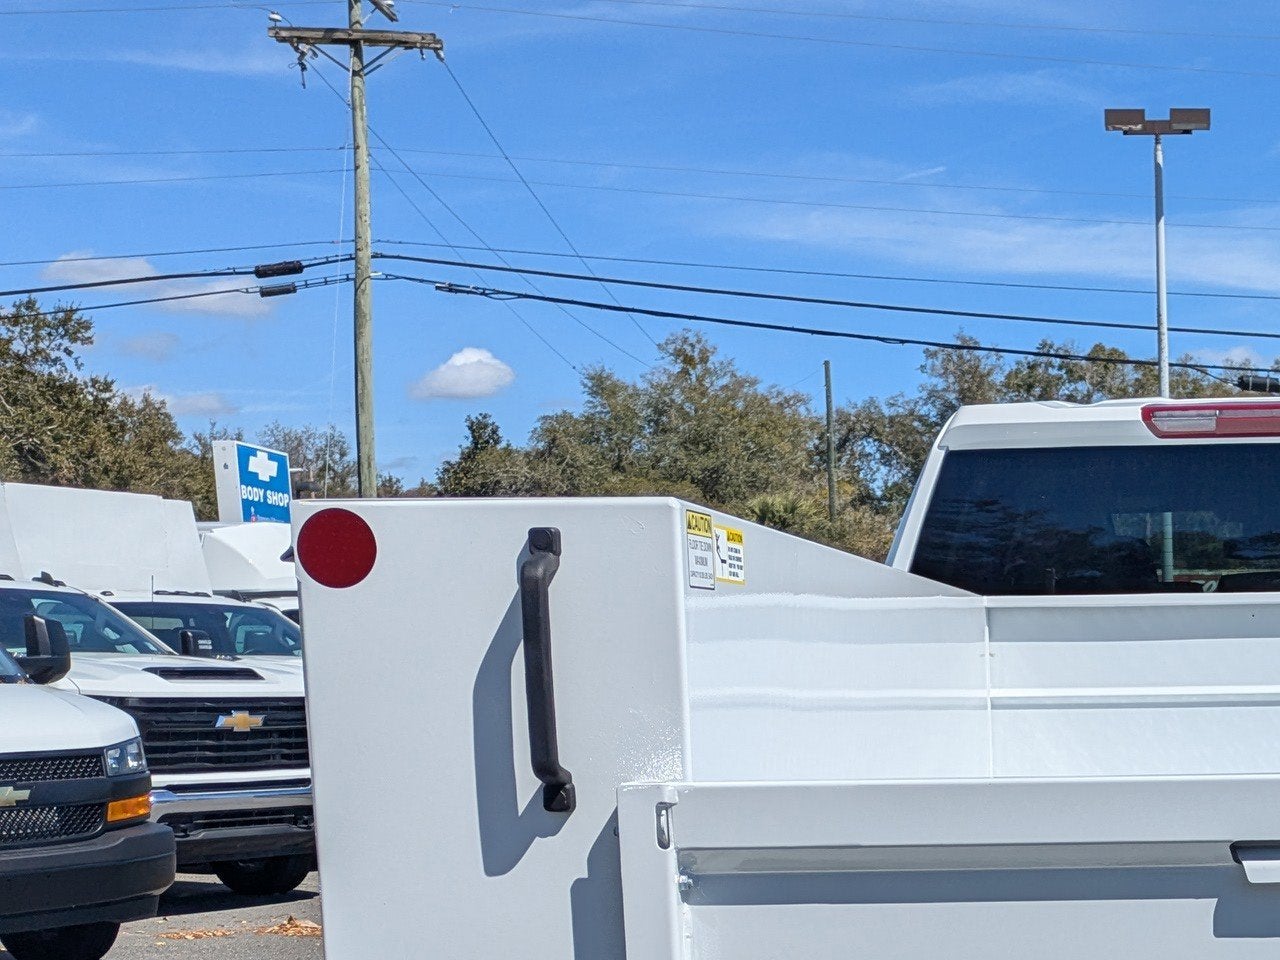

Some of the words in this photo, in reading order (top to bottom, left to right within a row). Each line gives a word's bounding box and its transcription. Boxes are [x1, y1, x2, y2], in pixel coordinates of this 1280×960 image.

[241, 485, 264, 502] BODY
[266, 490, 289, 507] SHOP
[691, 514, 711, 533] CAUTION
